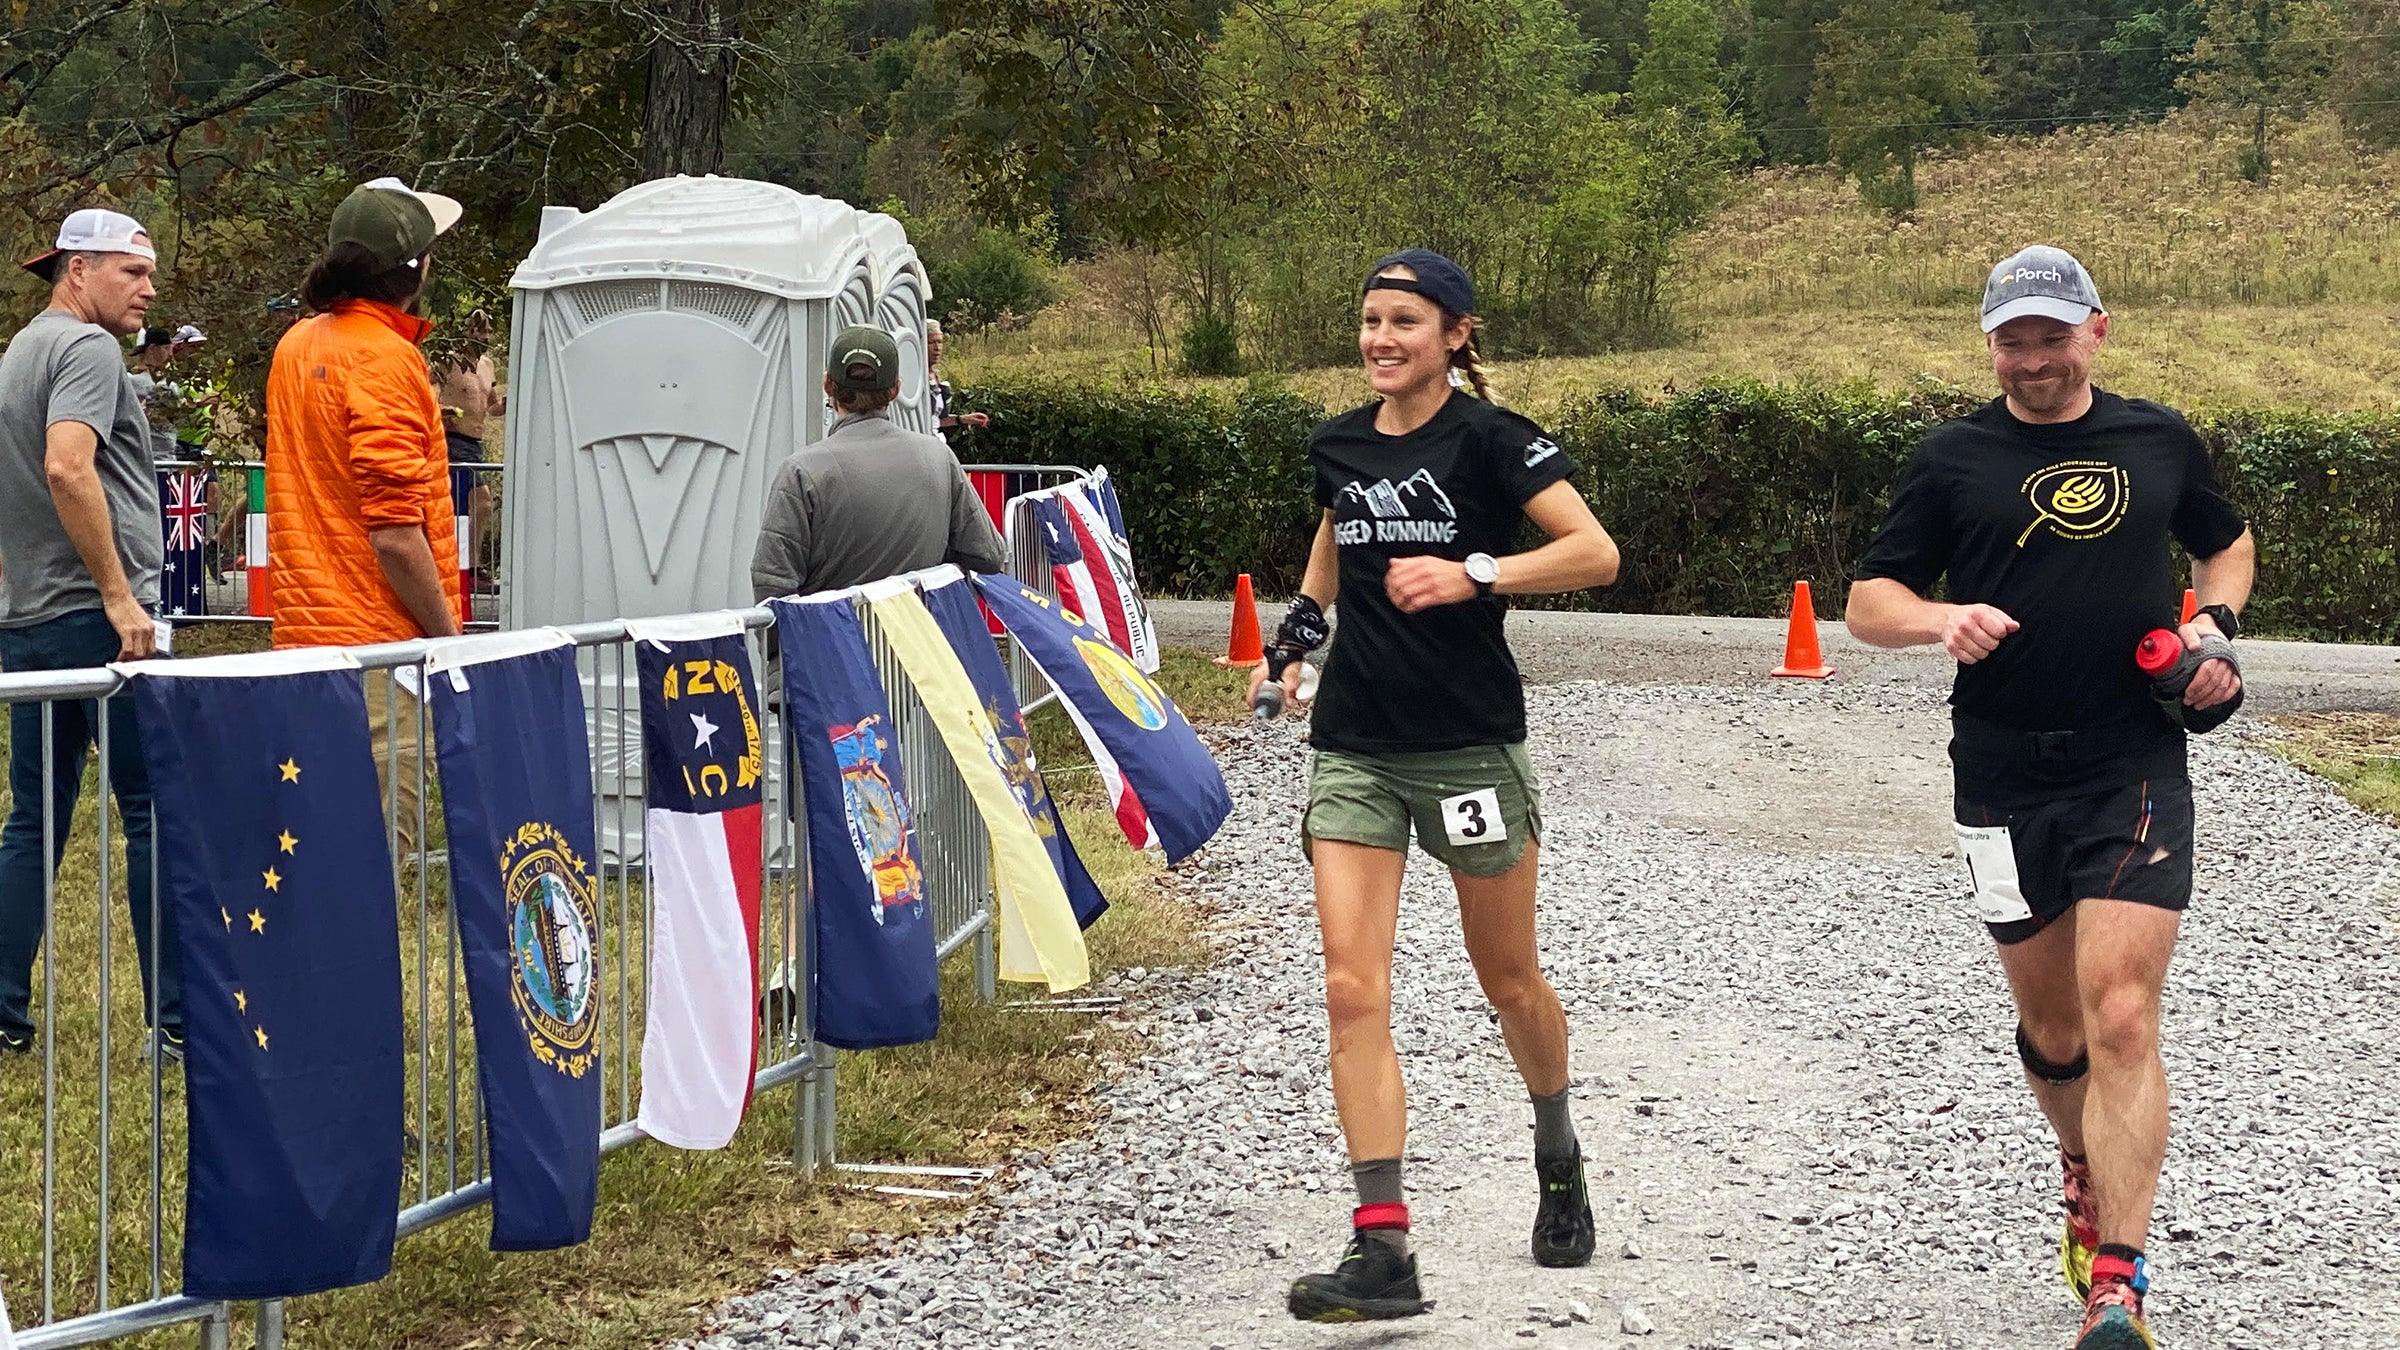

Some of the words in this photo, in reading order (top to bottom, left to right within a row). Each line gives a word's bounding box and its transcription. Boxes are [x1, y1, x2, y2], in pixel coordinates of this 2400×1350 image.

[2015, 266, 2062, 283] Porch
[1375, 519, 1459, 543] RUNNING
[1122, 594, 1145, 658] REPUBLIC
[749, 735, 760, 770] 1775
[1458, 800, 1487, 838] 3
[510, 872, 531, 905] SEAL
